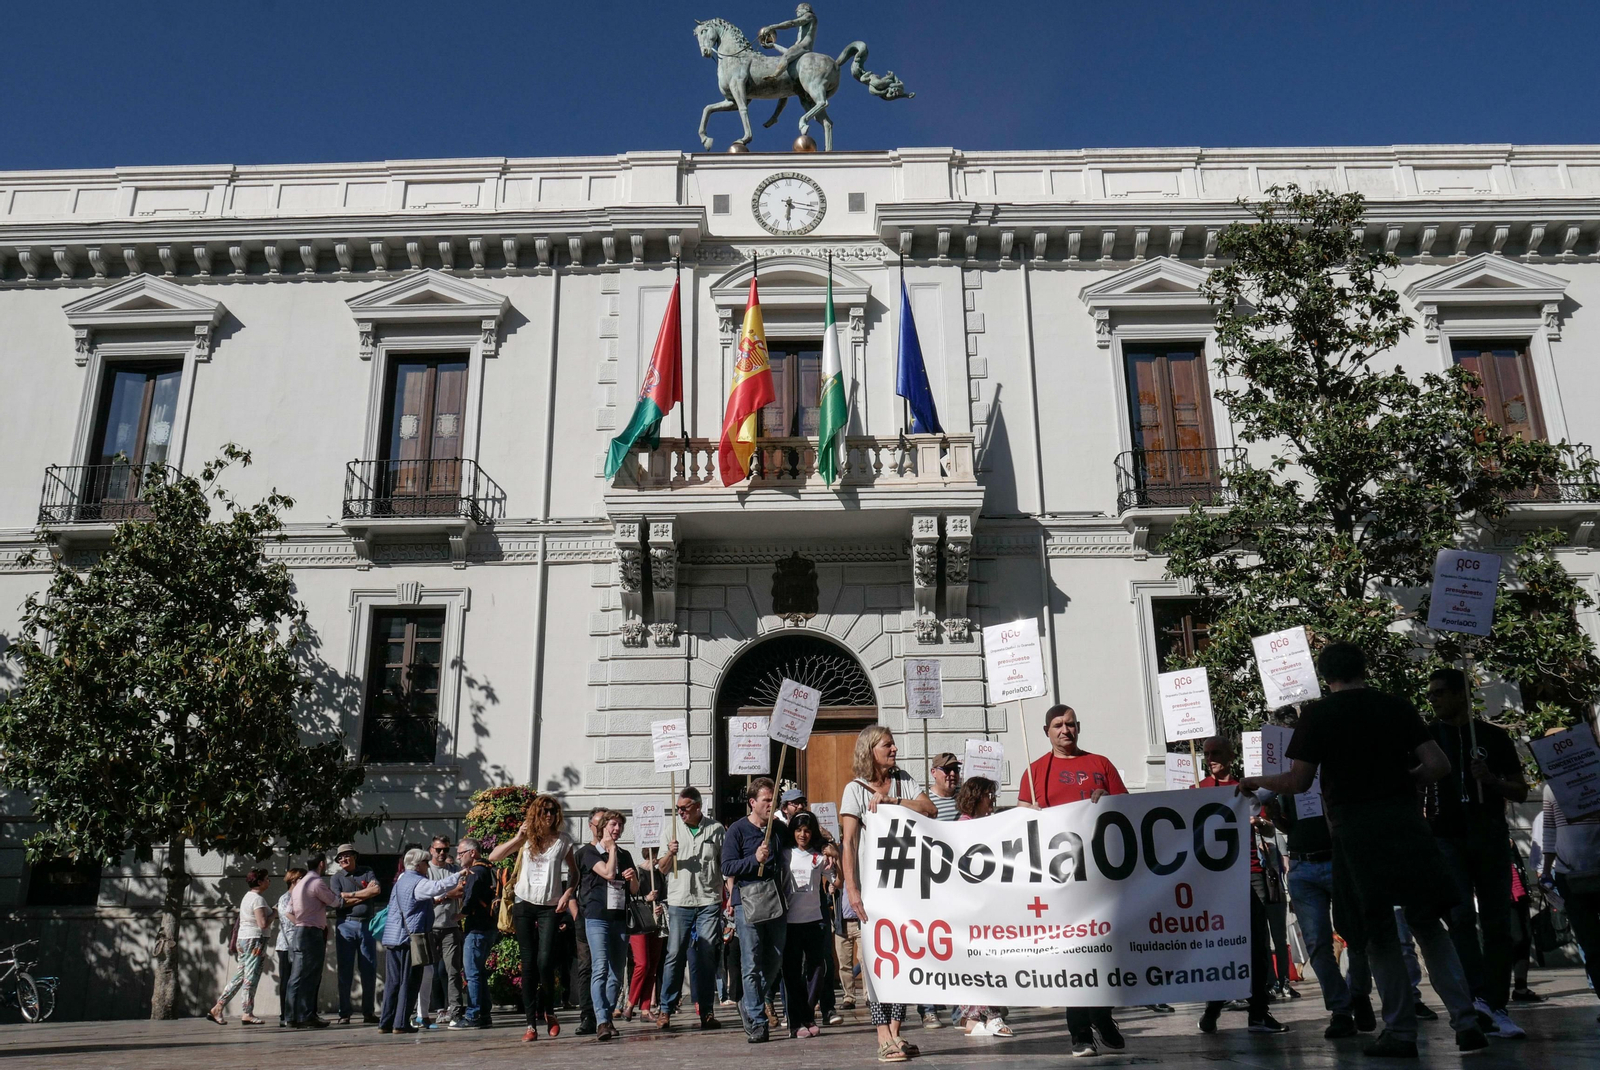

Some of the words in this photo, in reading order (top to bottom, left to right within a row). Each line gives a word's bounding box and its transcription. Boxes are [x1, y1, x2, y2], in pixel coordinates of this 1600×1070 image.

[1446, 587, 1483, 596] presupuesto
[1442, 618, 1477, 628] #porlaOCG
[998, 656, 1030, 666] presupuesto
[1270, 662, 1301, 674] presupuesto
[1002, 686, 1032, 696] #porlaOCG
[1177, 727, 1203, 735] #porlaOCG
[876, 803, 1240, 900] #porlaOCG
[1175, 883, 1193, 909] 0
[1149, 910, 1224, 934] deuda
[968, 919, 1111, 944] presupuesto
[1130, 940, 1187, 953] liquidación
[1190, 940, 1202, 949] de
[1206, 939, 1214, 948] la
[1217, 935, 1247, 947] deuda
[909, 967, 1008, 990] Orquesta
[1015, 968, 1099, 988] Ciudad
[1107, 968, 1137, 987] de
[1146, 961, 1250, 986] Granada
